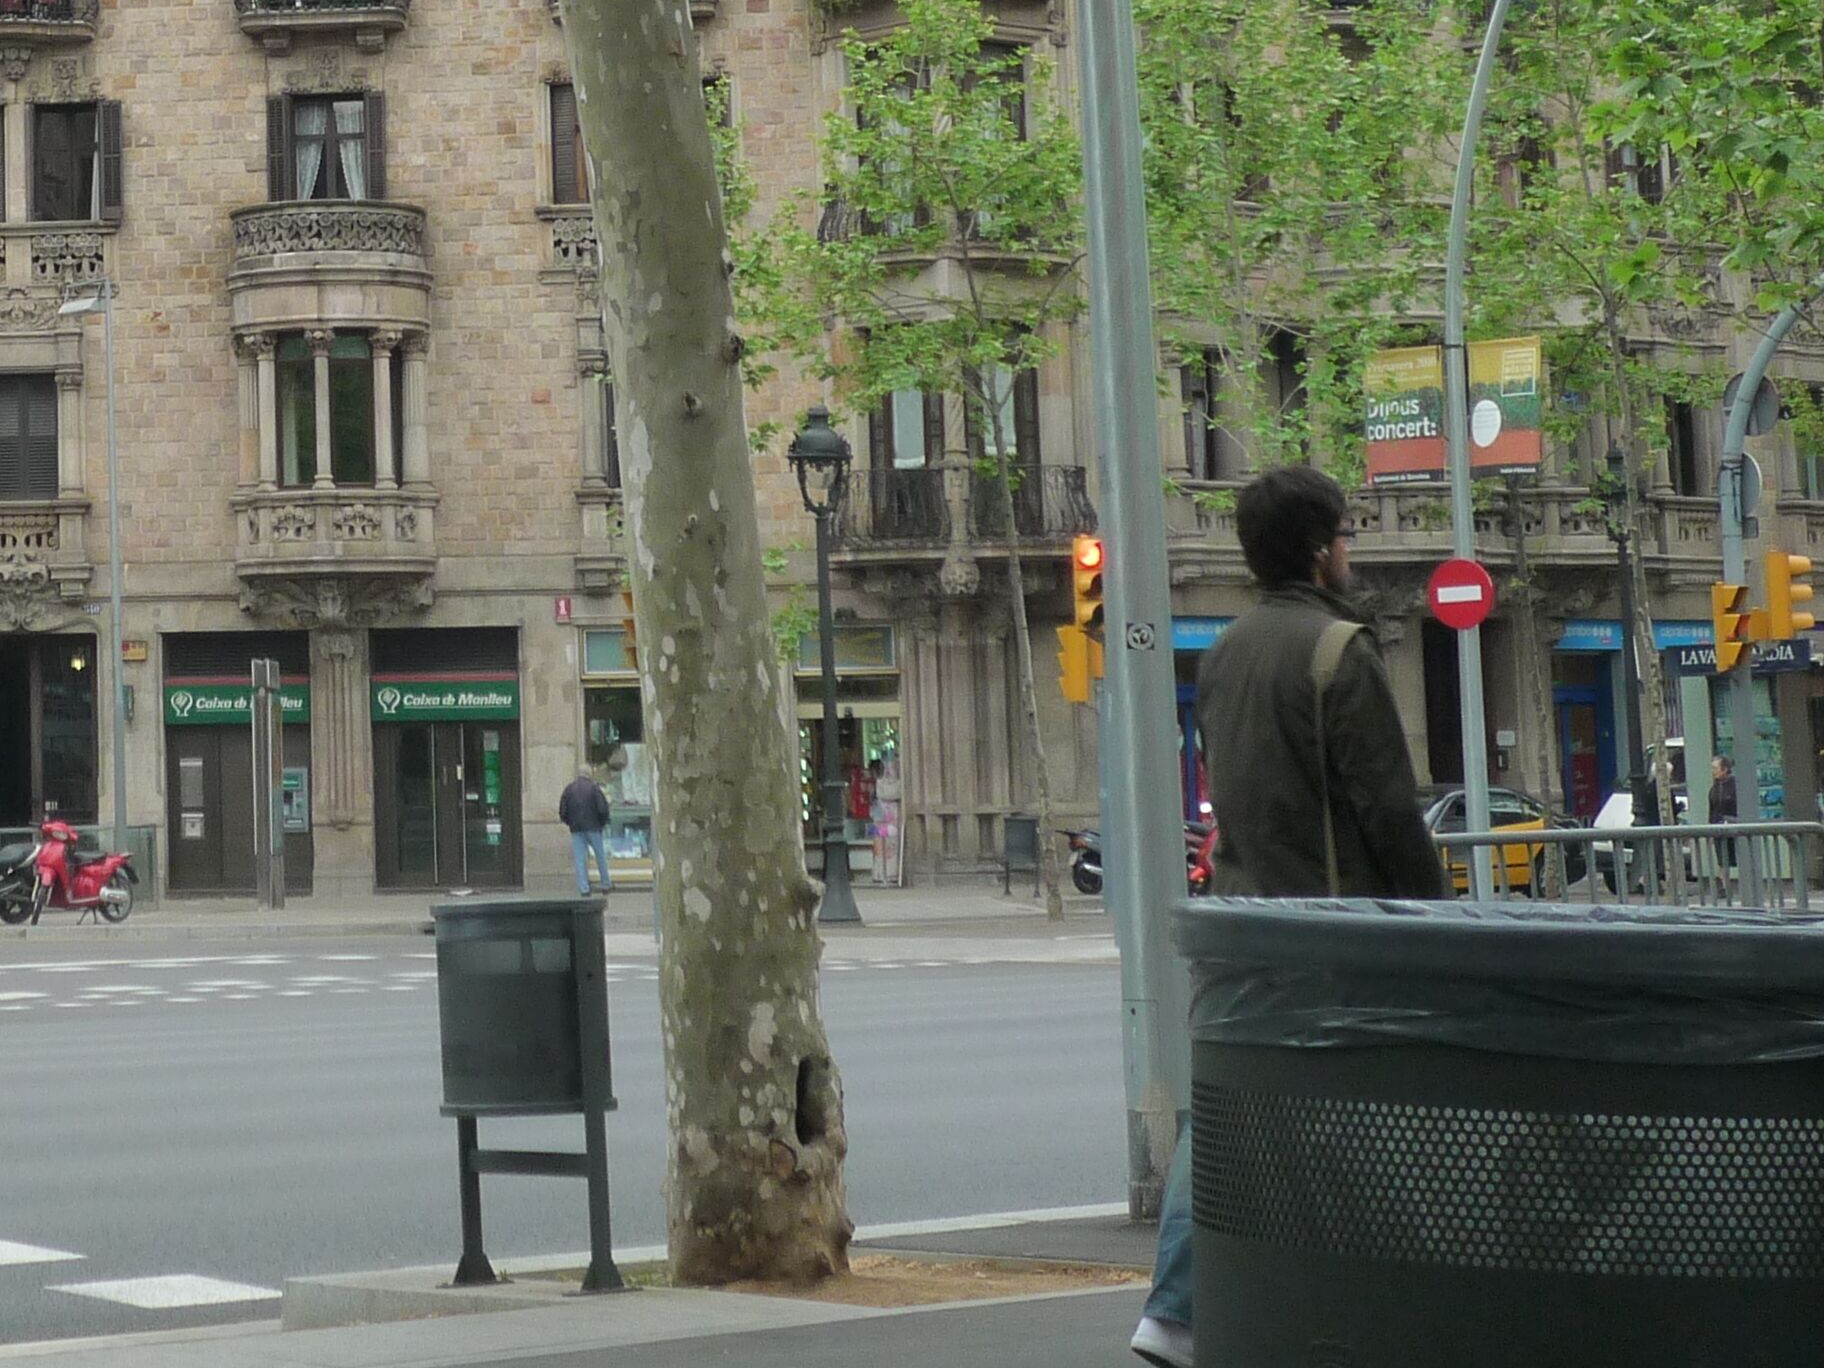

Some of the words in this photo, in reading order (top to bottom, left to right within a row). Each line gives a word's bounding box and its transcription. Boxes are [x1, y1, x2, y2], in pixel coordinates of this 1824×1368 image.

[1367, 398, 1420, 421] Dijous
[1367, 416, 1437, 441] concert:
[196, 696, 232, 709] Caixa
[403, 693, 441, 707] Caixa
[458, 692, 512, 706] Manlleu
